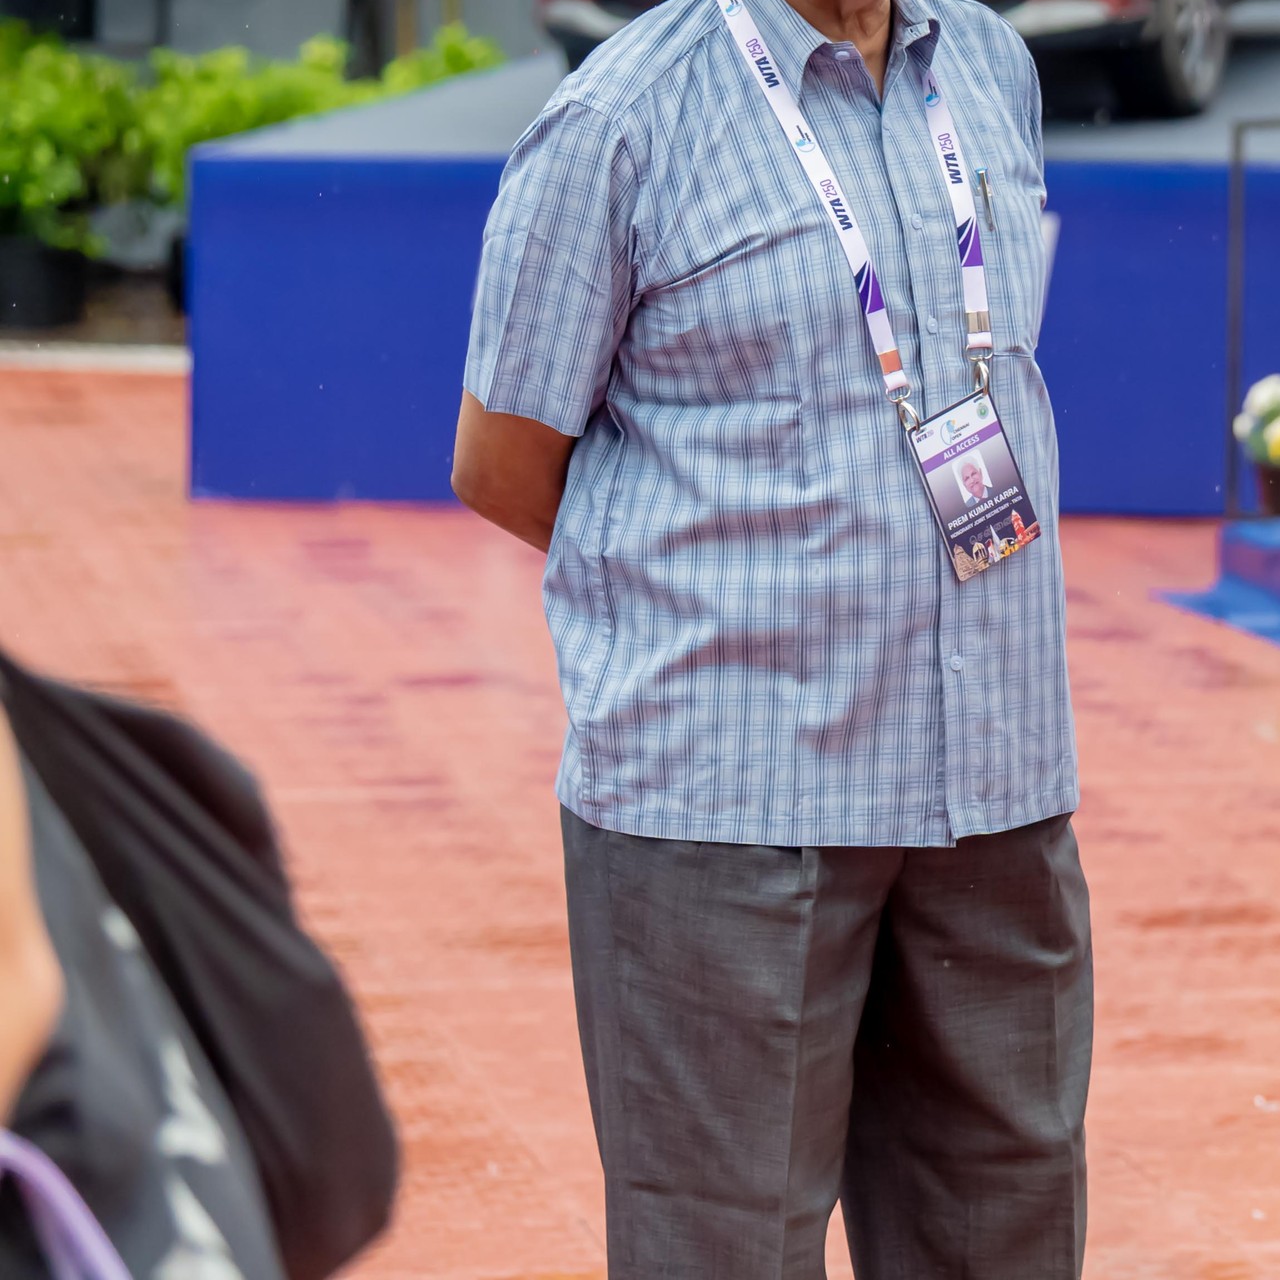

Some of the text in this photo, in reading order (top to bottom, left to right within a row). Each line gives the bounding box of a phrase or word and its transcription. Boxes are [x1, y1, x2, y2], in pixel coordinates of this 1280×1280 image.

[745, 38, 781, 88] WTA 250
[937, 132, 963, 185] WTA 250
[819, 179, 853, 231] WTA 250
[943, 434, 980, 460] ALL ACCESS
[947, 486, 1019, 531] PREM KUMAR KARRA
